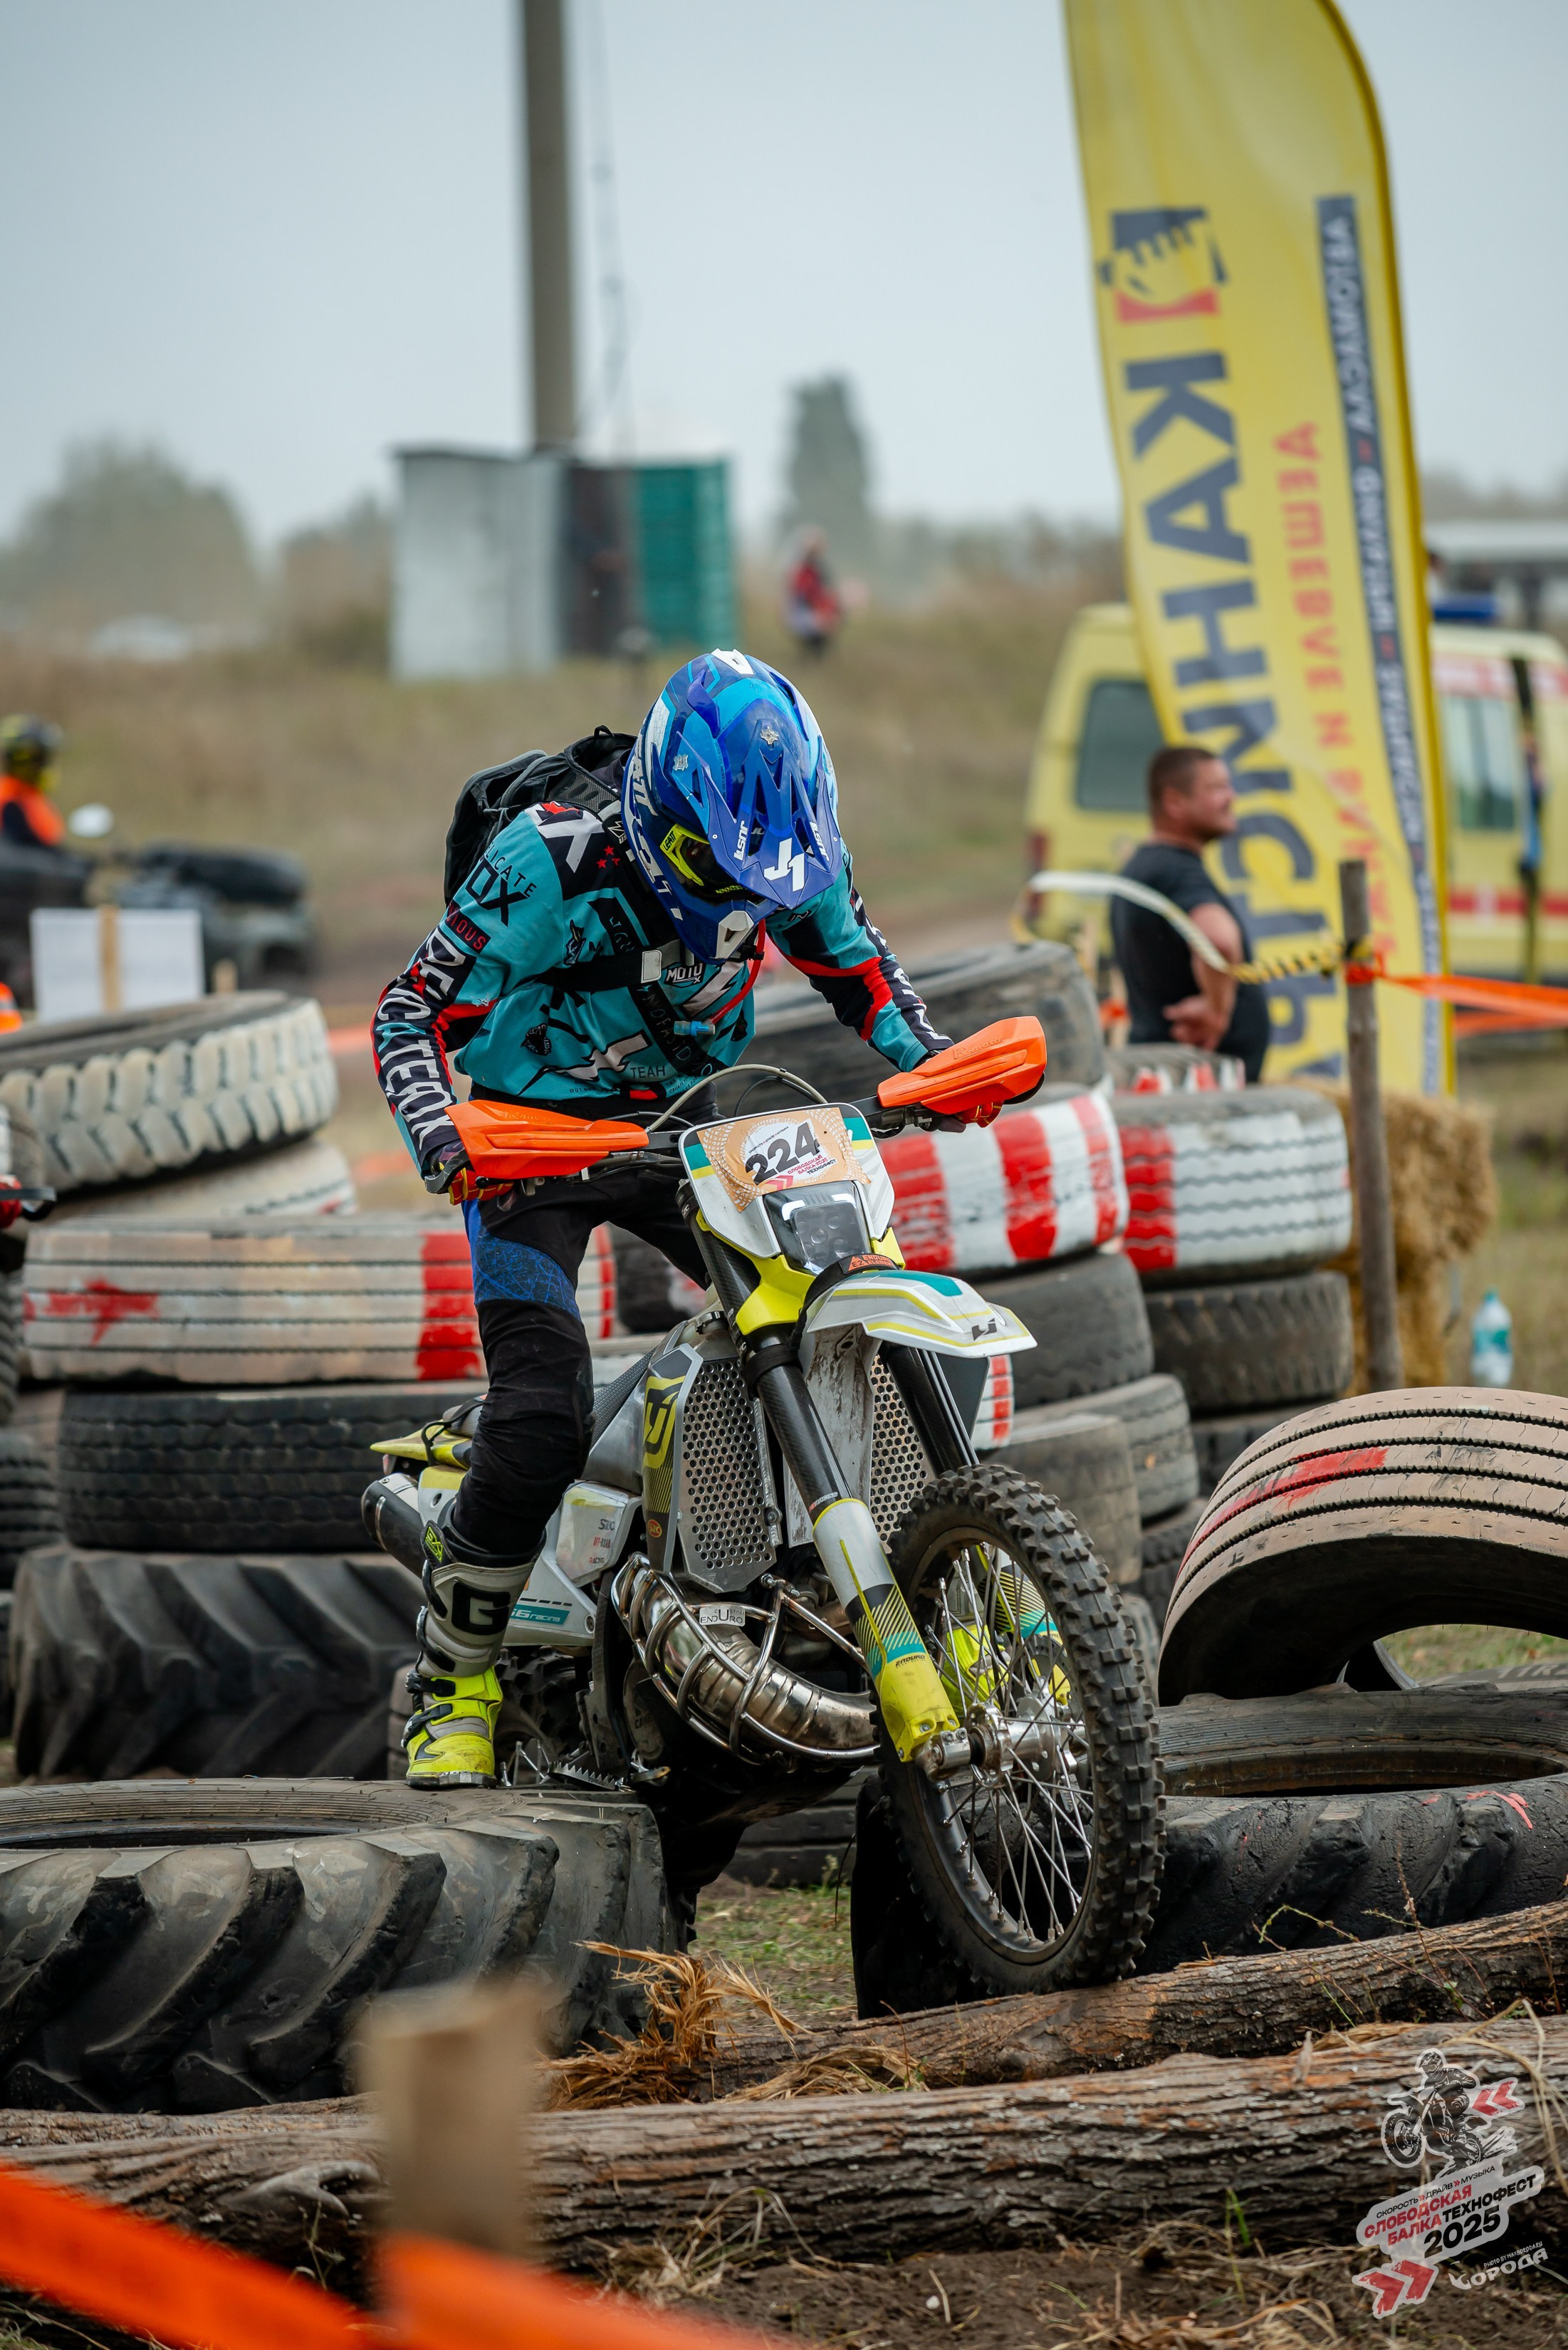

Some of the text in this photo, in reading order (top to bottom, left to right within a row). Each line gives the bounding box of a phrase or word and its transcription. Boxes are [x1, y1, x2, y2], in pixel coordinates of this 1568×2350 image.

[662, 830, 676, 850] LEATT
[465, 857, 528, 927] OX
[746, 1122, 820, 1186] 224
[787, 1154, 822, 1174] СЛОБОДСКАЯ
[798, 1165, 815, 1174] БАЛКА
[807, 1159, 837, 1175] ТЕХНОФЕСТ
[701, 1609, 743, 1624] ENDURO
